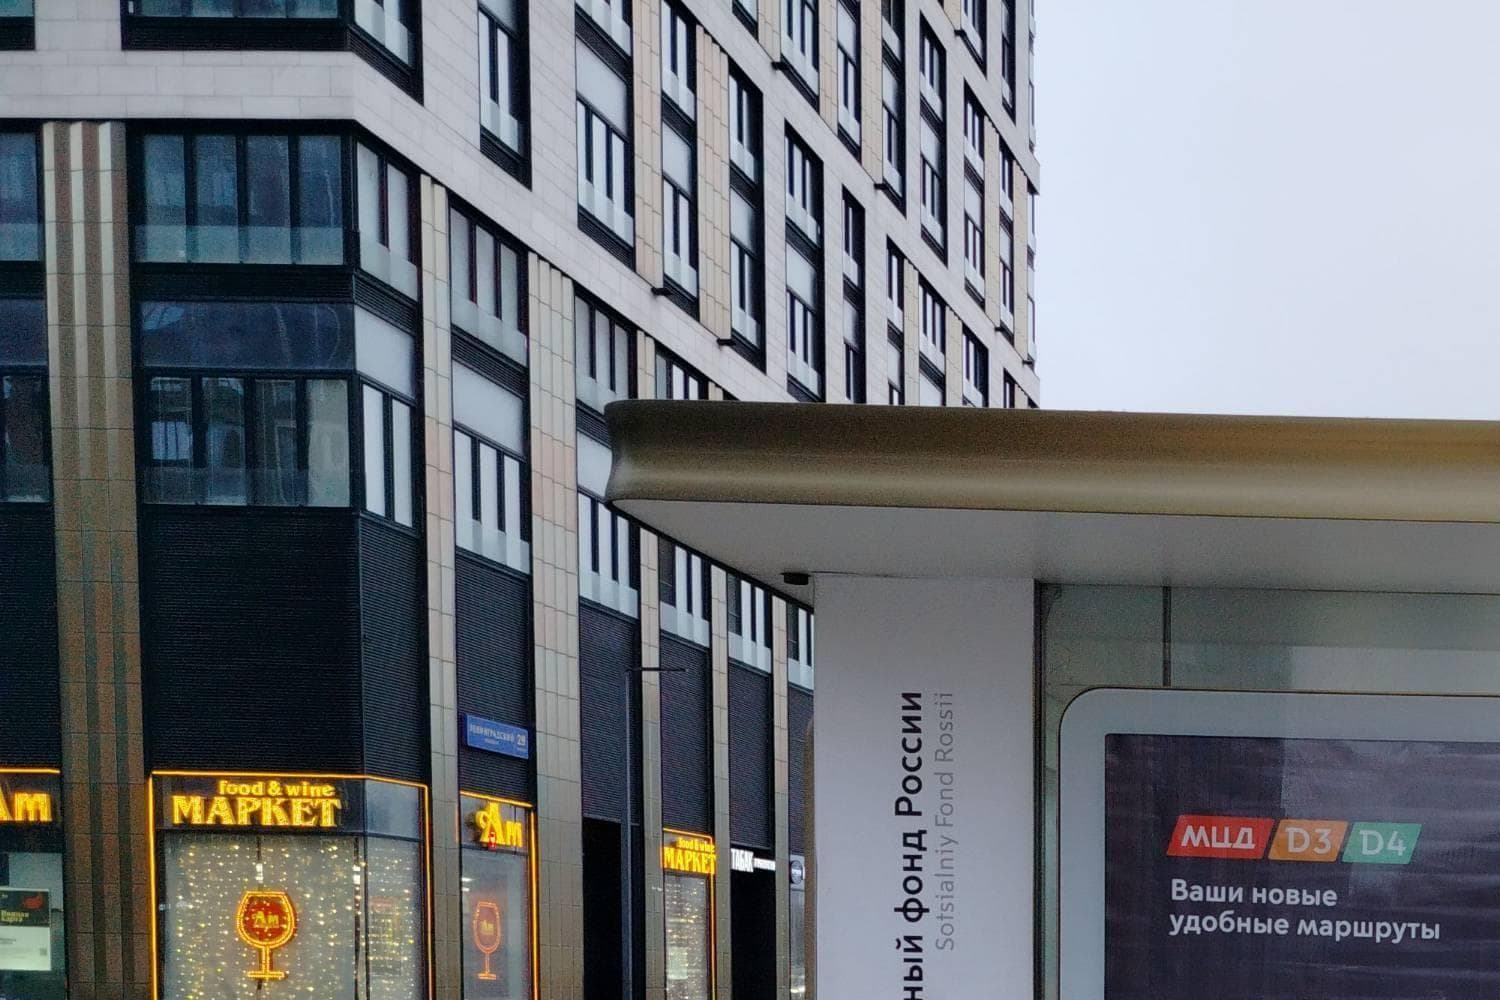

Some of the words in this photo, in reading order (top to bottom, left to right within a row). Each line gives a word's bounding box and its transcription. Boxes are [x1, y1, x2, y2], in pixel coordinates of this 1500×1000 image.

[934, 693, 954, 762] Rossii
[894, 693, 923, 816] России
[219, 780, 265, 796] food
[267, 781, 284, 797] &
[286, 782, 336, 797] wine
[934, 772, 954, 827] Fond
[172, 796, 342, 828] МАРКЕТ
[1181, 825, 1255, 850] МЦД
[1285, 827, 1332, 853] D3
[1359, 829, 1407, 856] D4
[664, 846, 716, 874] МАРКЕТ
[894, 830, 930, 923] фонд
[935, 835, 959, 951] Sotsialniy
[1171, 878, 1243, 903] Ваши
[1252, 887, 1338, 906] новые
[1169, 910, 1290, 936] удобные
[1297, 917, 1440, 944] маршруты
